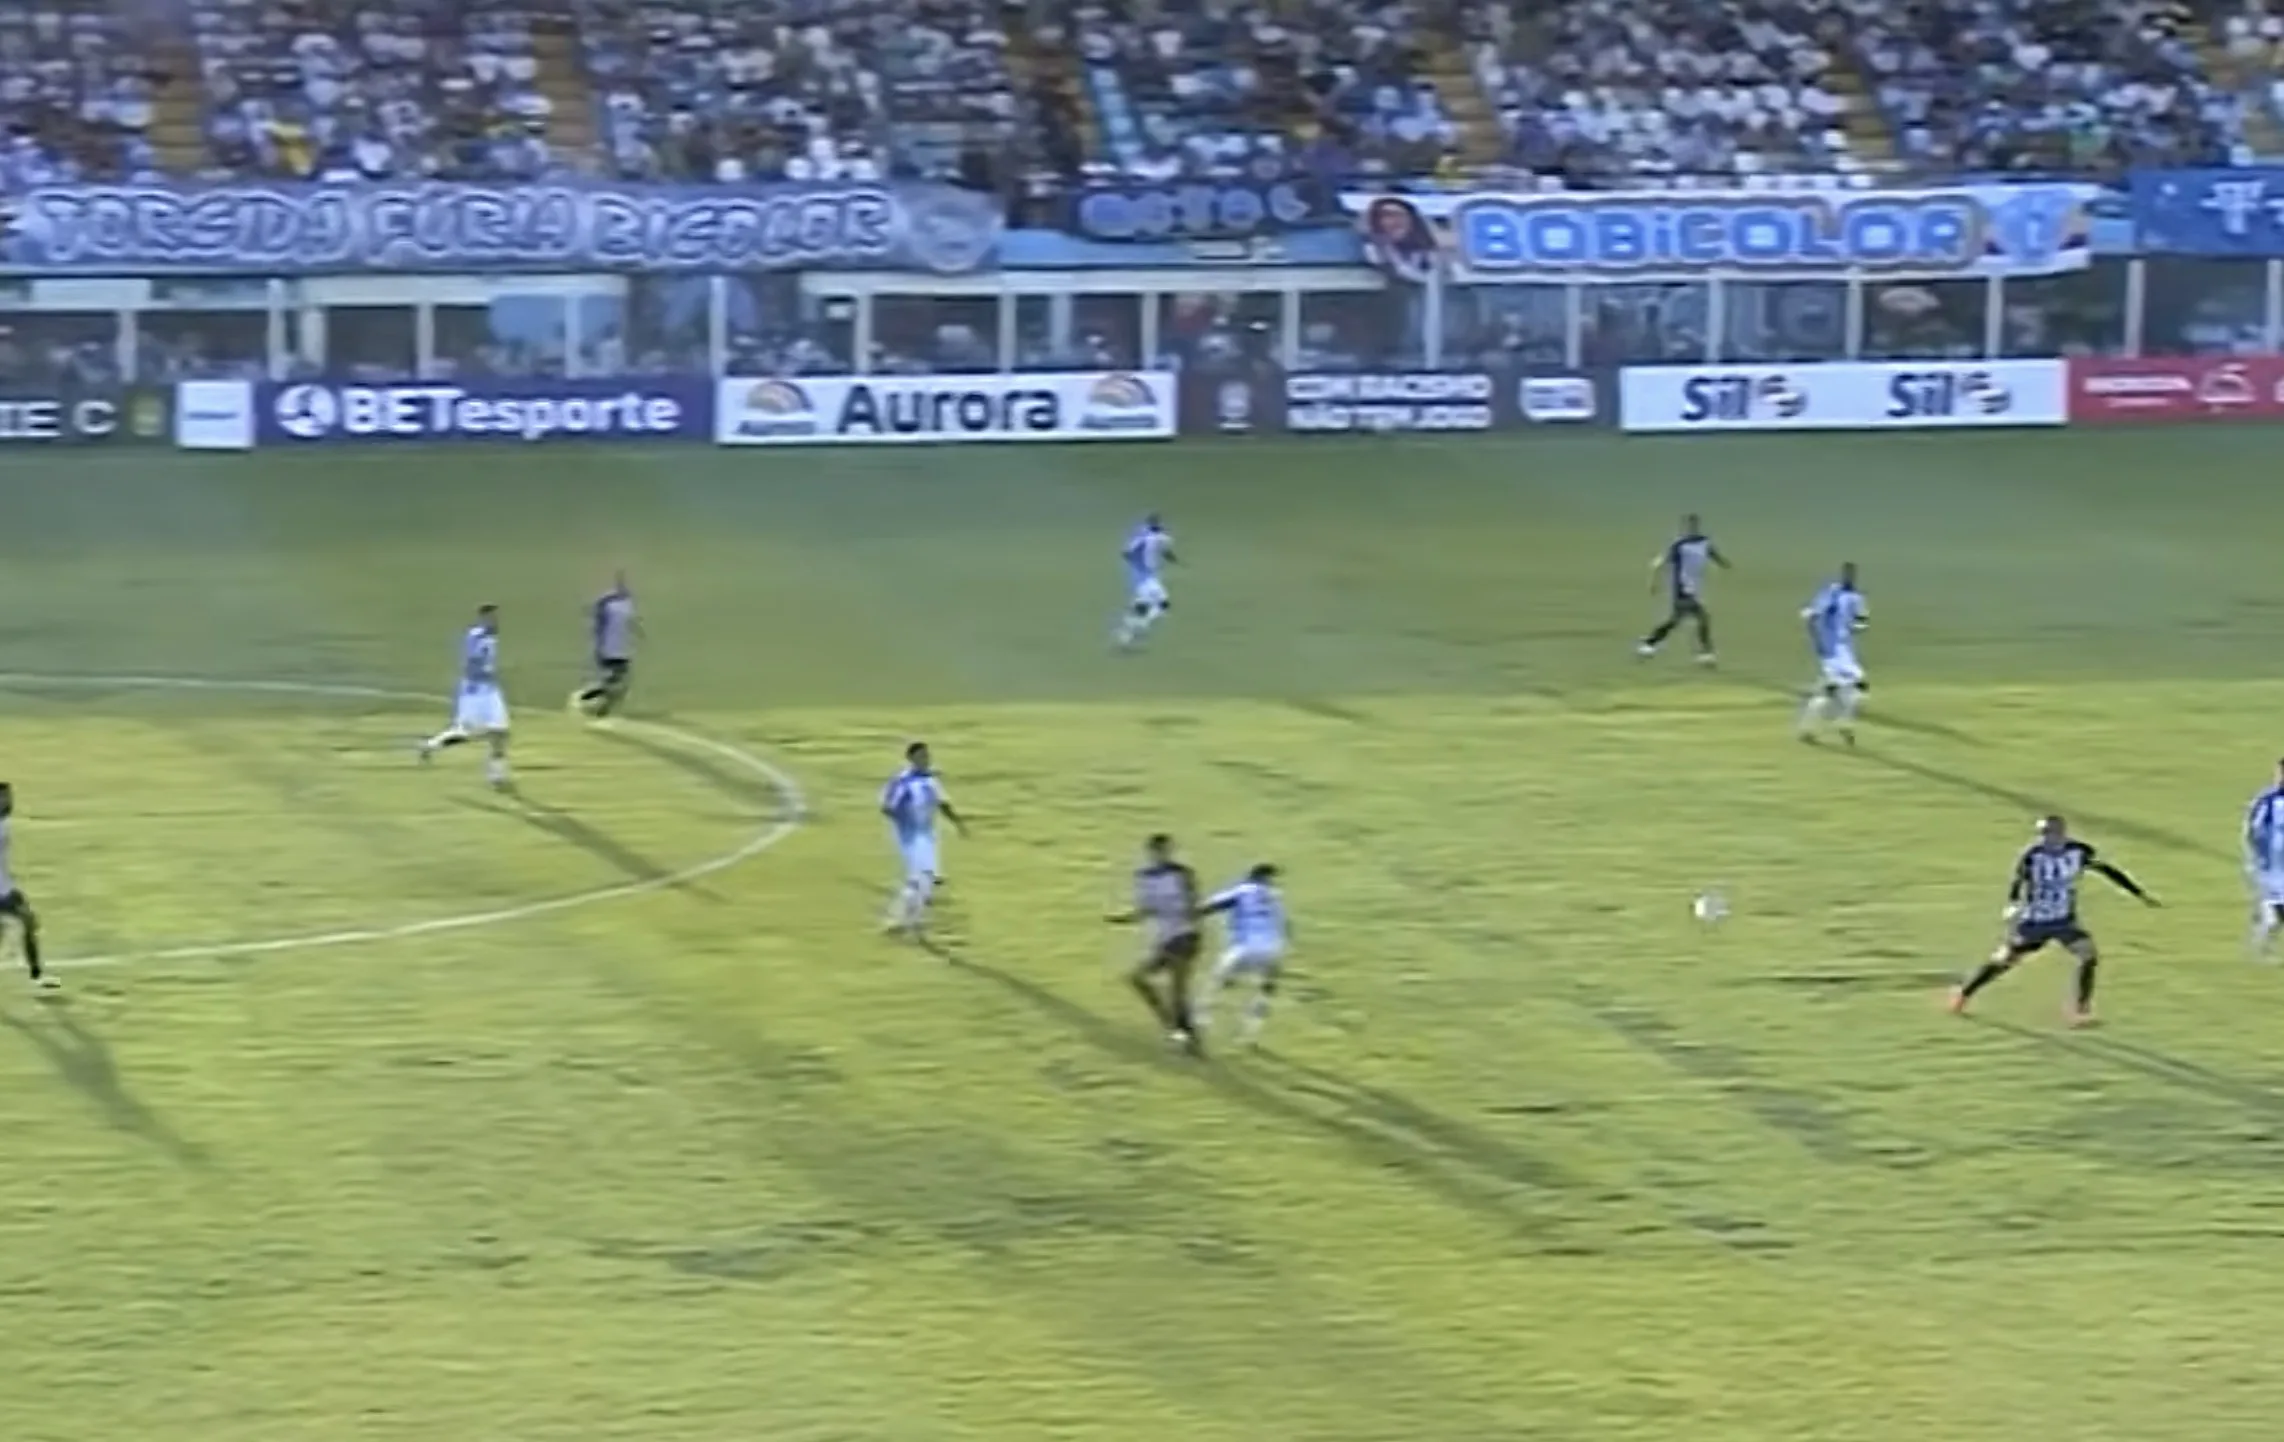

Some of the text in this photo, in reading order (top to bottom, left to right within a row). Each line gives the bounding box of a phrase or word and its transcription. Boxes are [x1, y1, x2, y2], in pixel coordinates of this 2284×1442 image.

[73, 400, 117, 435] C
[341, 386, 682, 440] BETesporte
[836, 384, 1060, 434] Aurora
